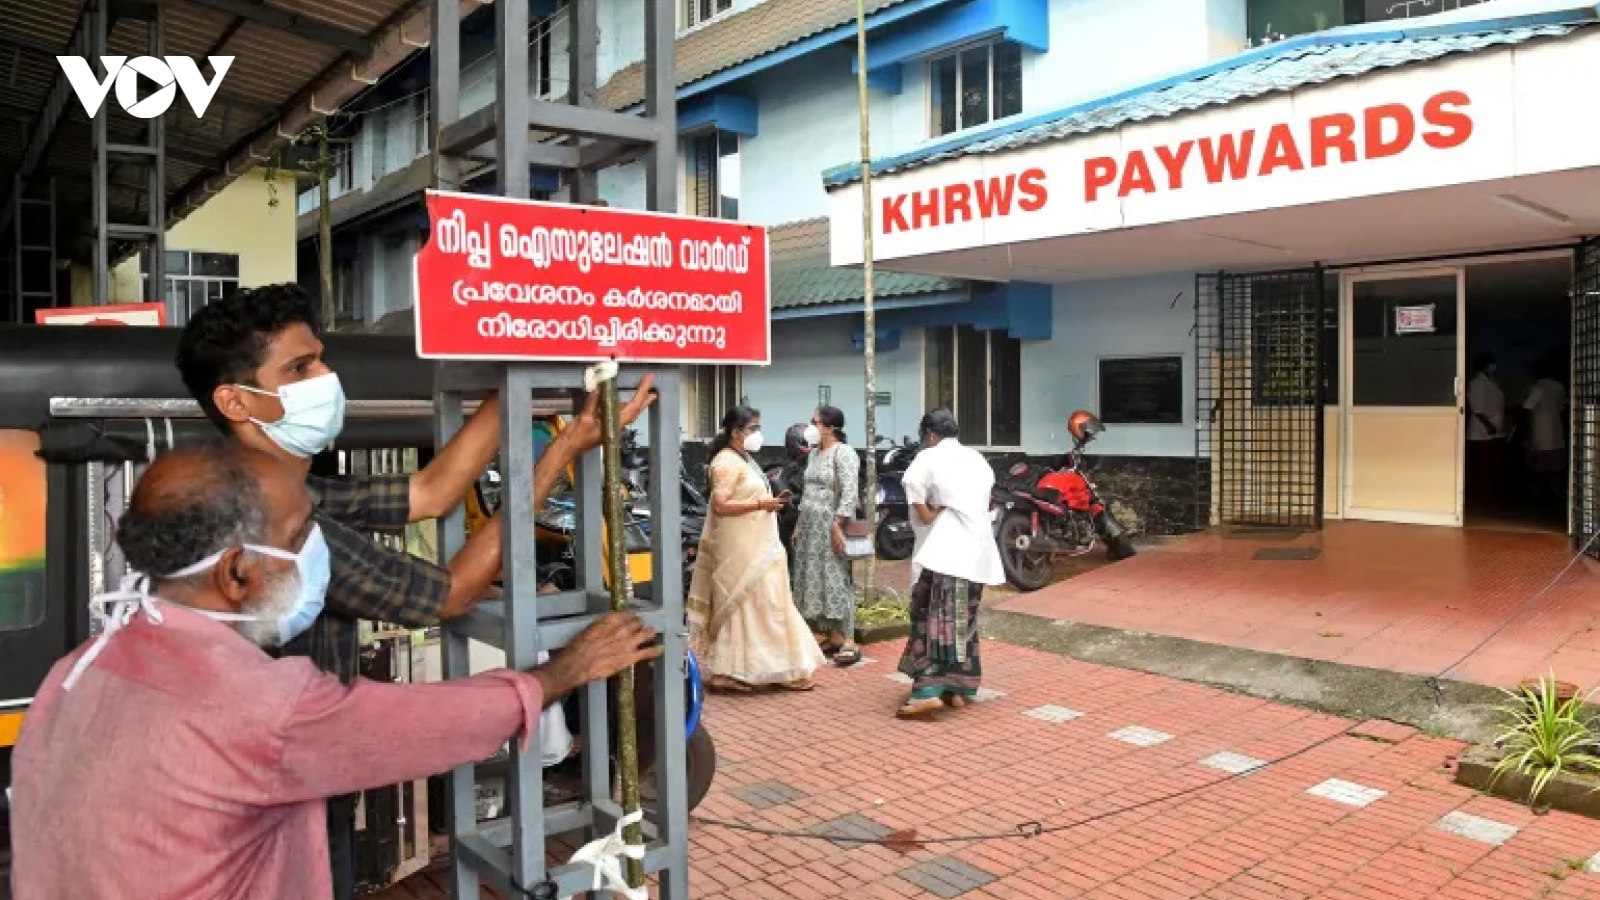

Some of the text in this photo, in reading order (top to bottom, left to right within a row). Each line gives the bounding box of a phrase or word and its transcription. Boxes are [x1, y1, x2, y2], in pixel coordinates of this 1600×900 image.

[883, 91, 1473, 234] KHRWS PAYWARDS
[437, 209, 491, 269] നിപ്പ
[680, 236, 751, 273] വാർഡ്
[453, 280, 742, 313] പ്രവേശനം കർശനമായി
[477, 312, 726, 349] നിരോധിച്ചിരിക്കുന്നു
